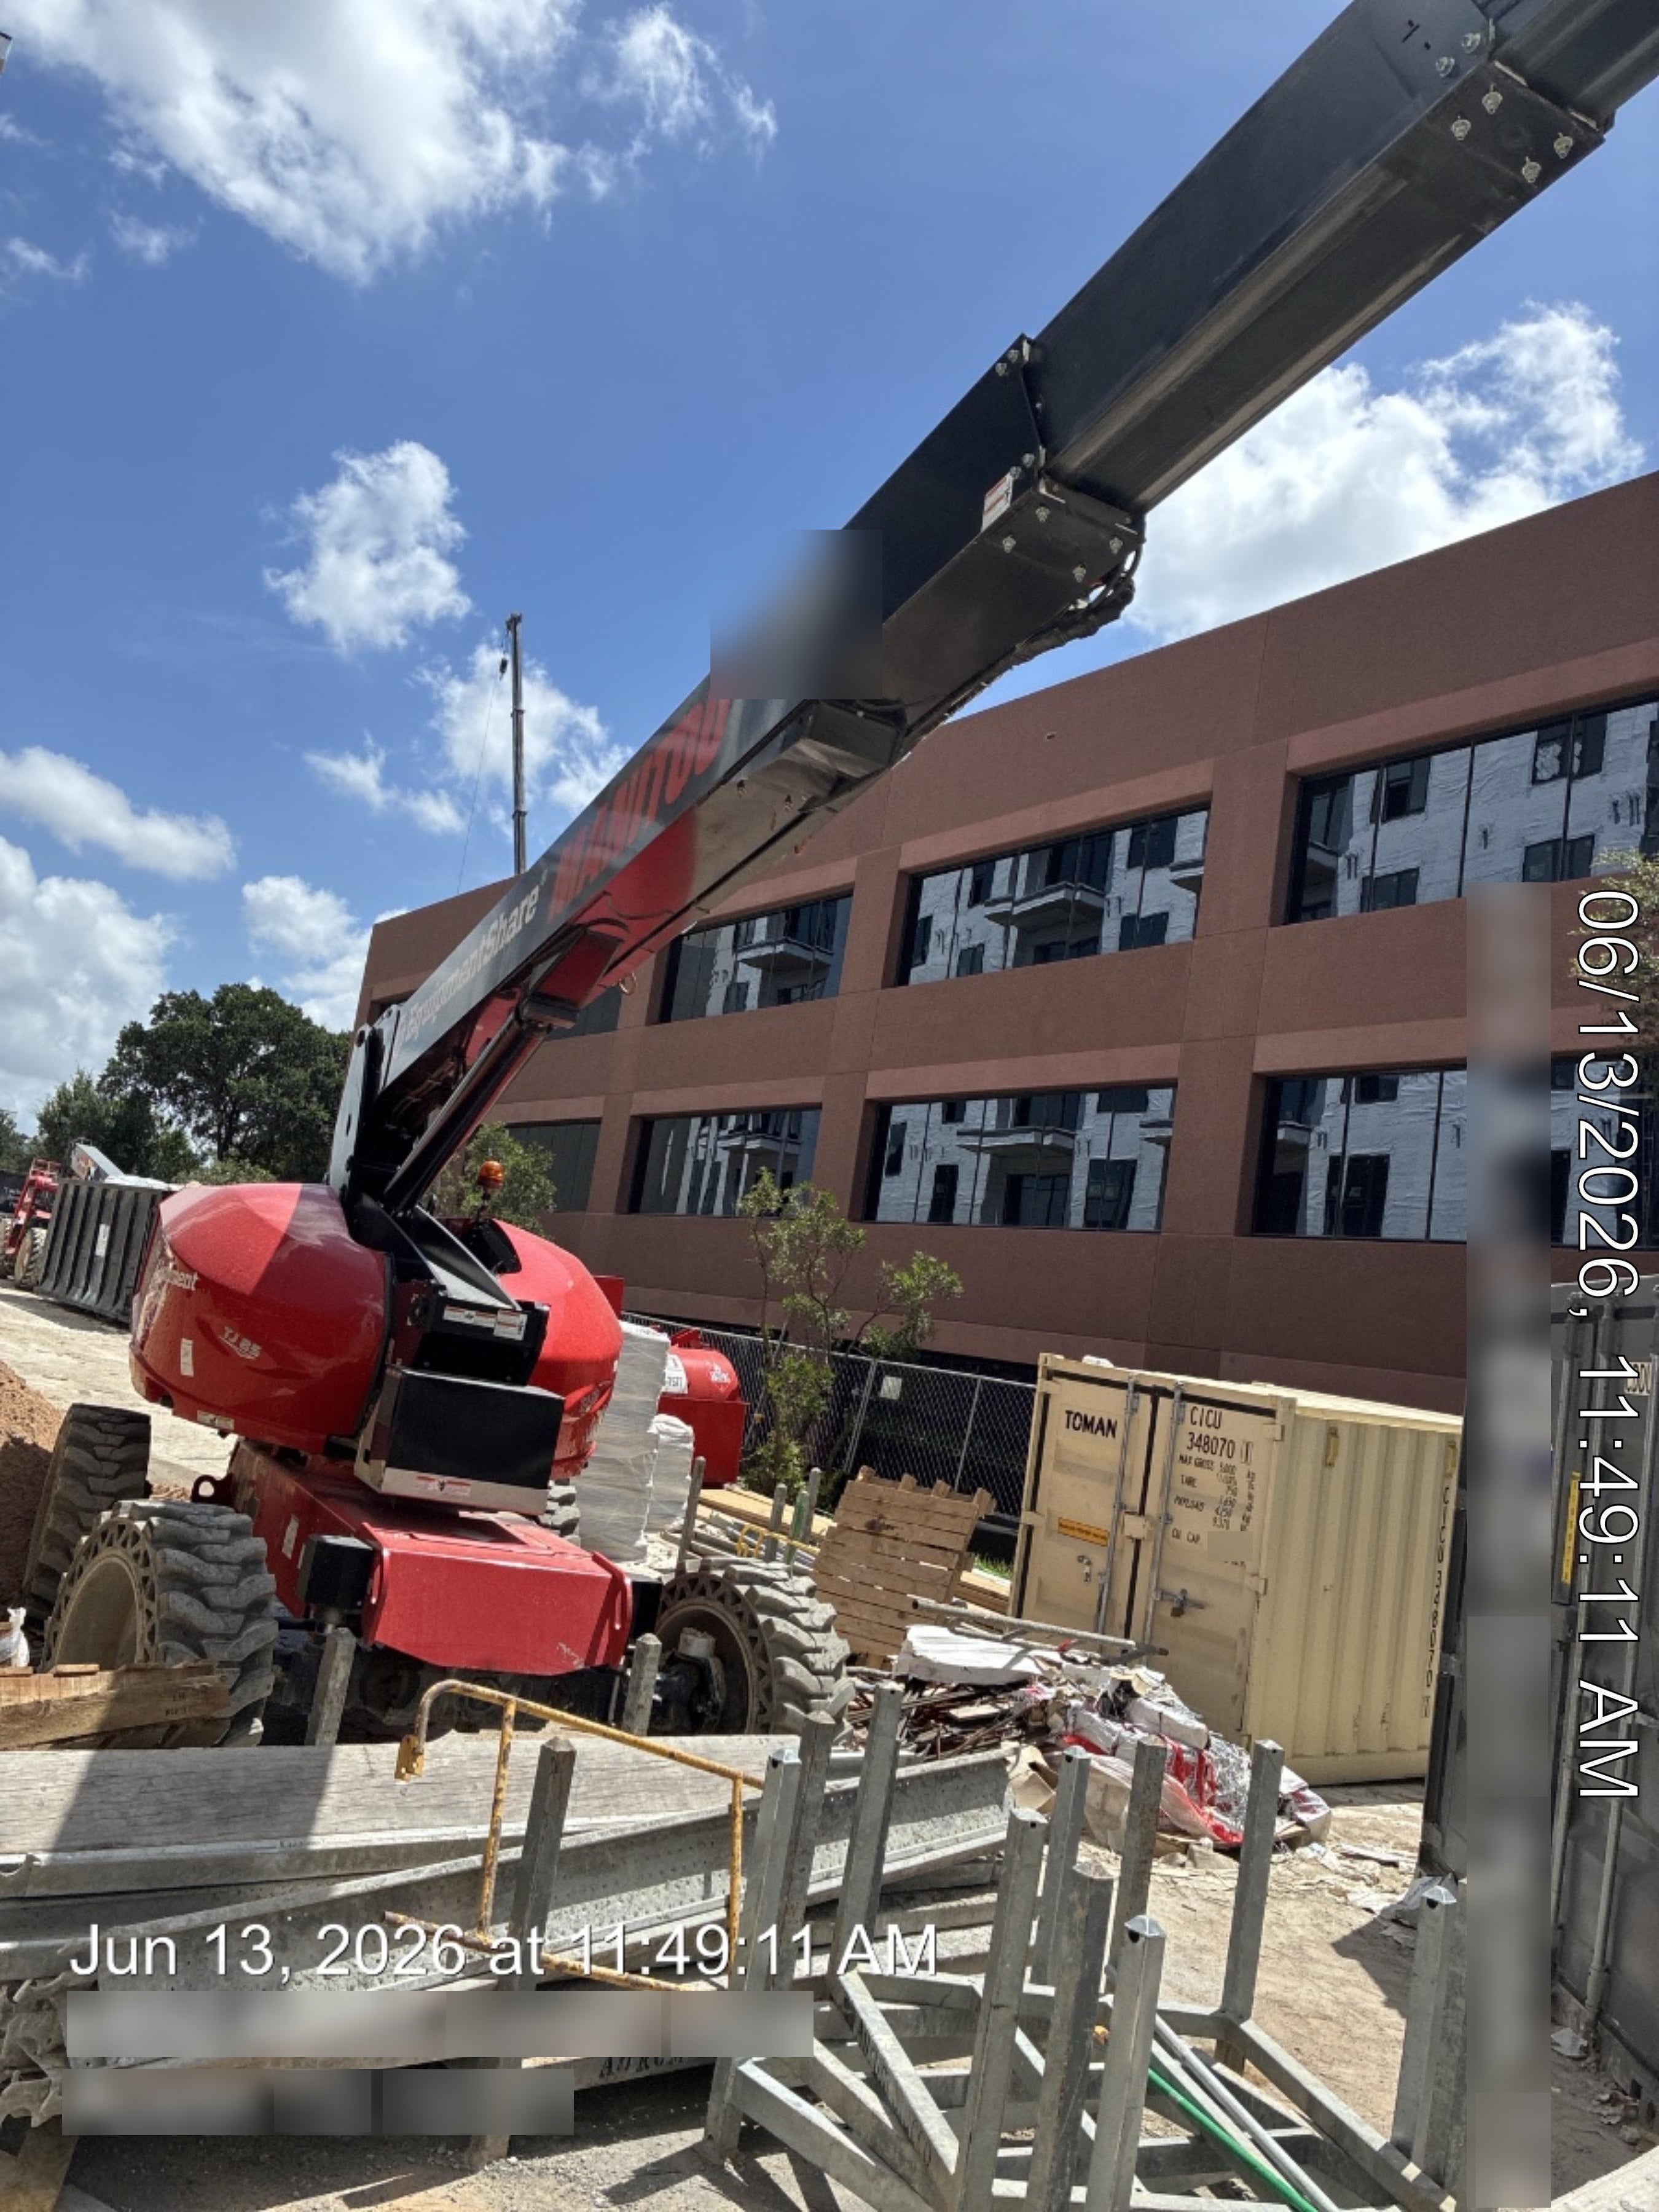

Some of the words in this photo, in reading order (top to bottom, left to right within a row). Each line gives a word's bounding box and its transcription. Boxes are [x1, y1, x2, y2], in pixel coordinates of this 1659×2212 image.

[547, 694, 731, 922] MANITOU
[1065, 1410, 1118, 1439] TOMAN
[1190, 1405, 1223, 1429] CICU
[1186, 1432, 1236, 1459] 348070
